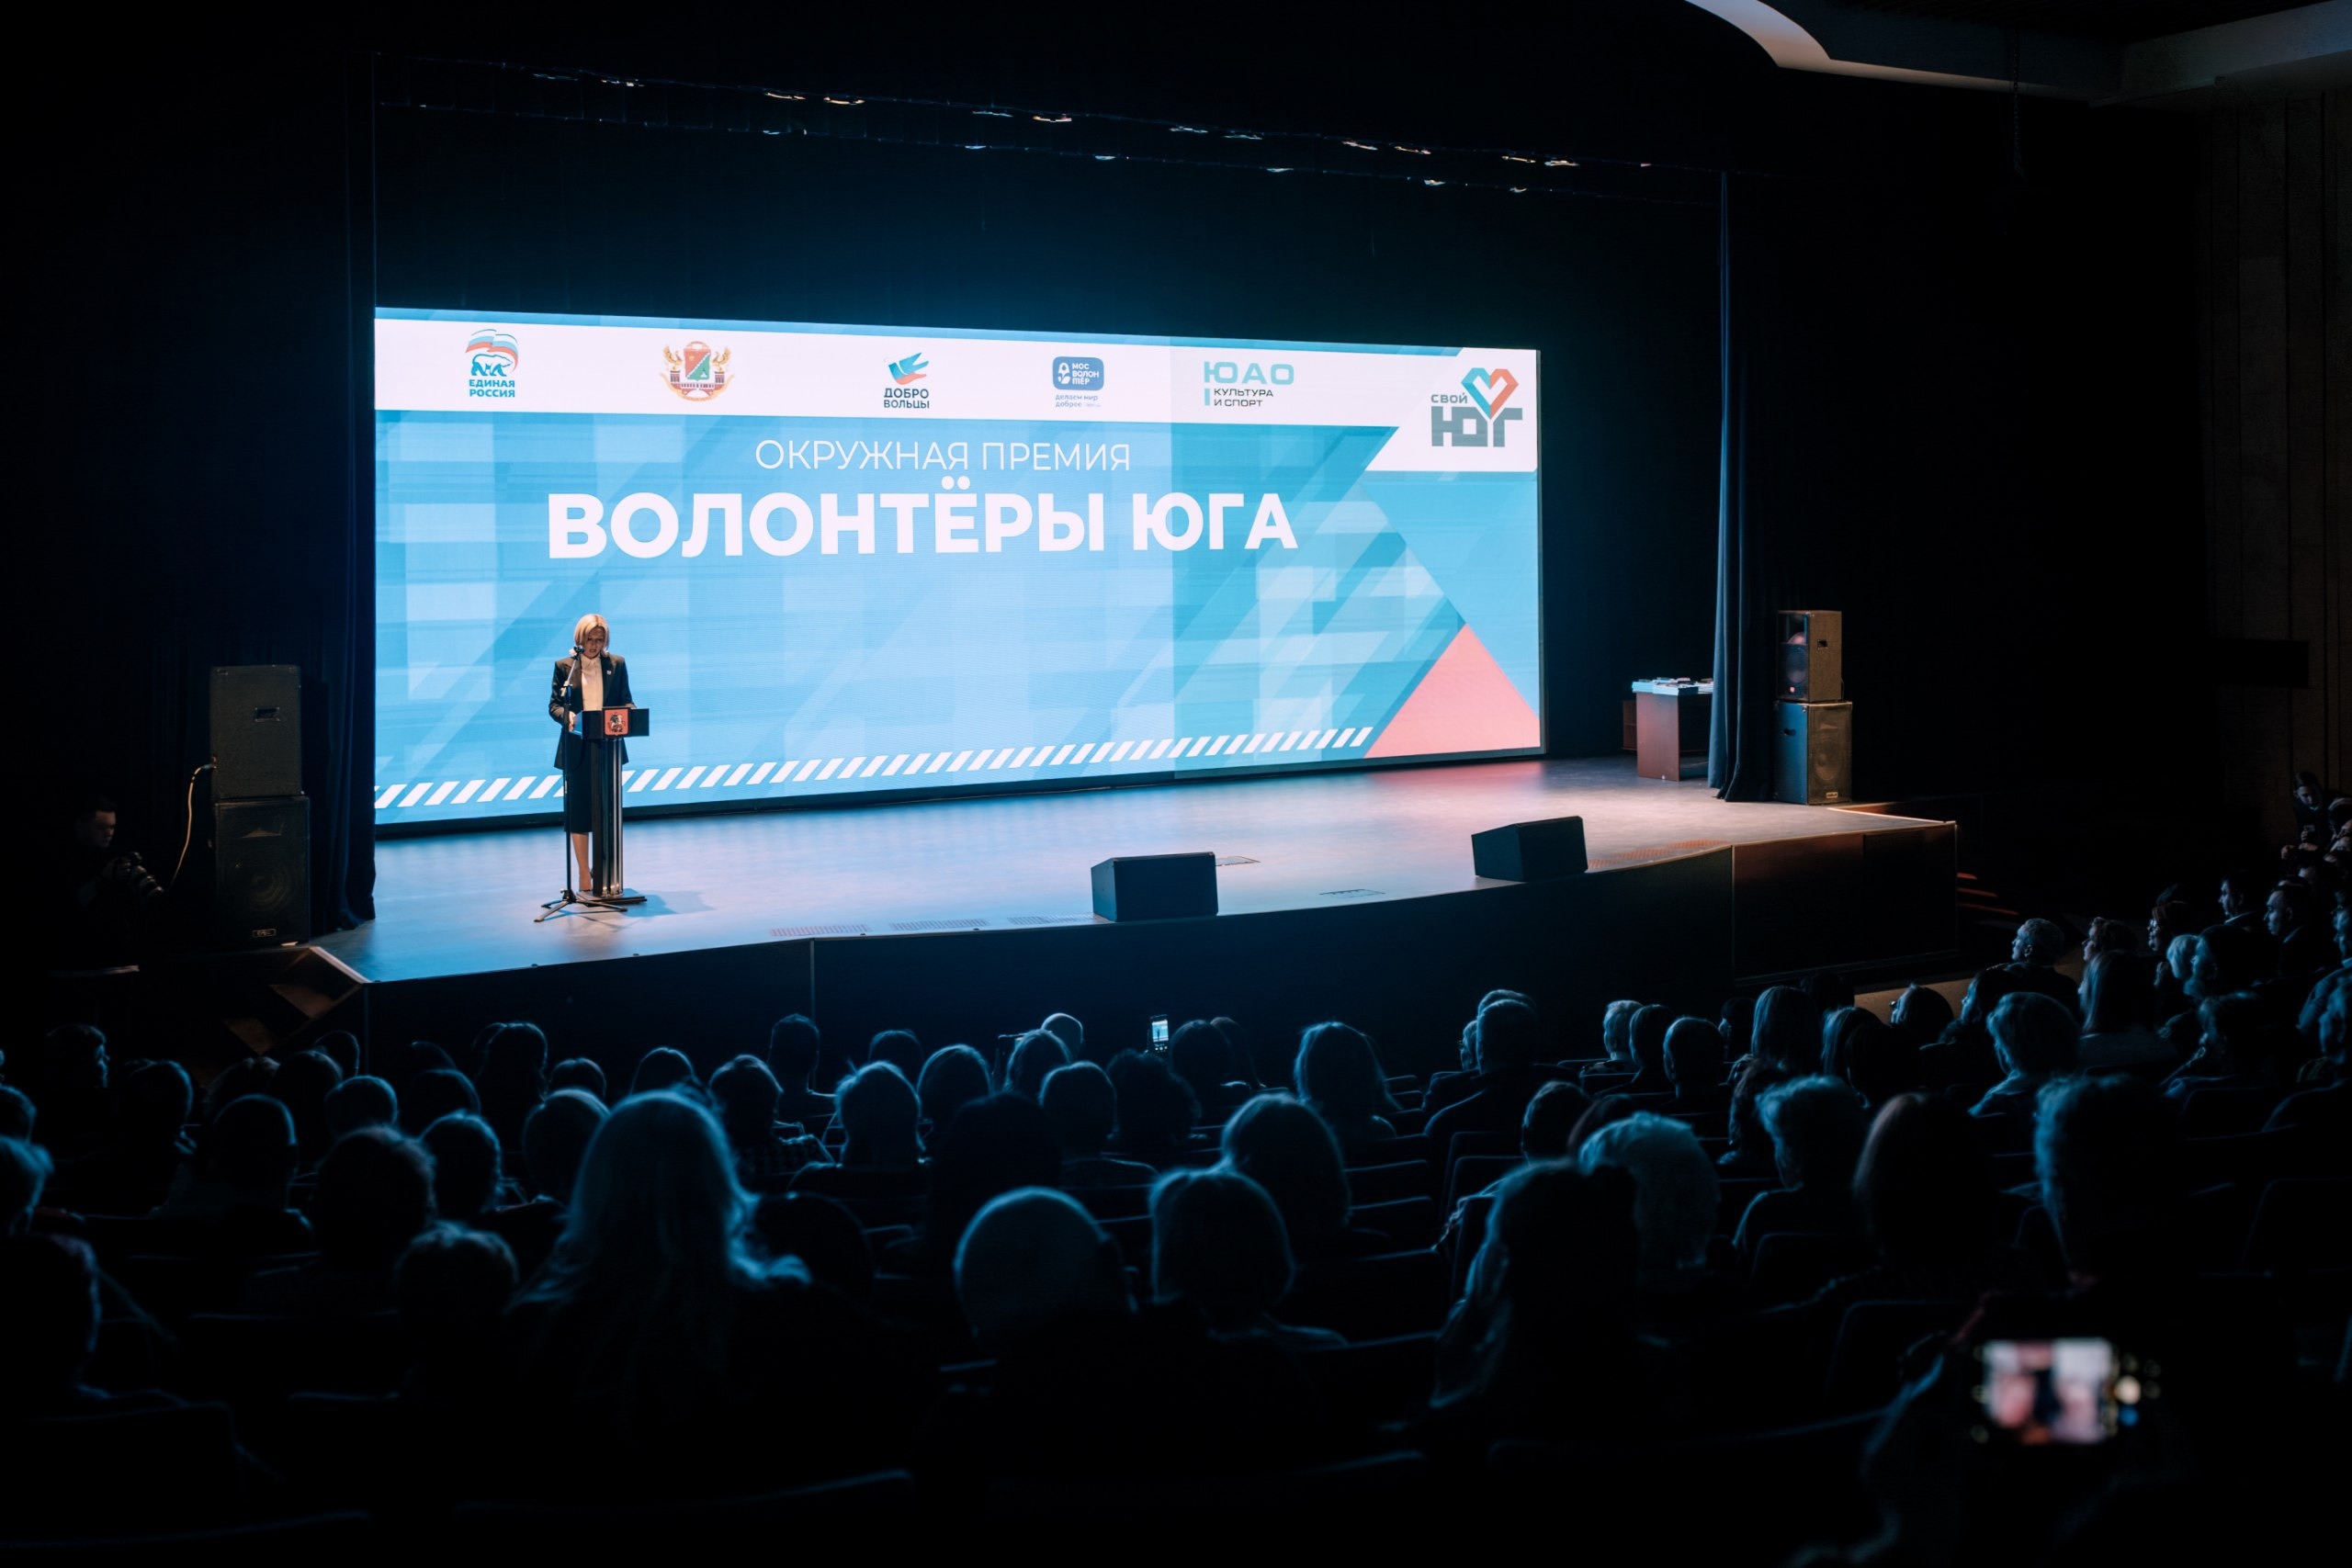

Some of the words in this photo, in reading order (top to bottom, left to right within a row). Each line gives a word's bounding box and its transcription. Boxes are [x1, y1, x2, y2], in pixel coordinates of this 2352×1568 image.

[1204, 361, 1295, 385] ЮАО
[469, 379, 515, 388] ЕДИНАЯ
[469, 389, 515, 398] РОССИЯ
[884, 388, 930, 399] ДОБРО
[1214, 389, 1273, 397] КУЛЬТУРА
[1430, 392, 1468, 403] СВОЙ
[884, 400, 930, 409] ВОЛЬЦЫ
[1431, 406, 1523, 447] ЮГ
[755, 439, 968, 471] ОКРУЖНАЯ
[982, 442, 1130, 471] ПРЕМИЯ
[548, 476, 1104, 559] ВОЛОНТЁРЫ
[1133, 491, 1298, 551] ЮГА
